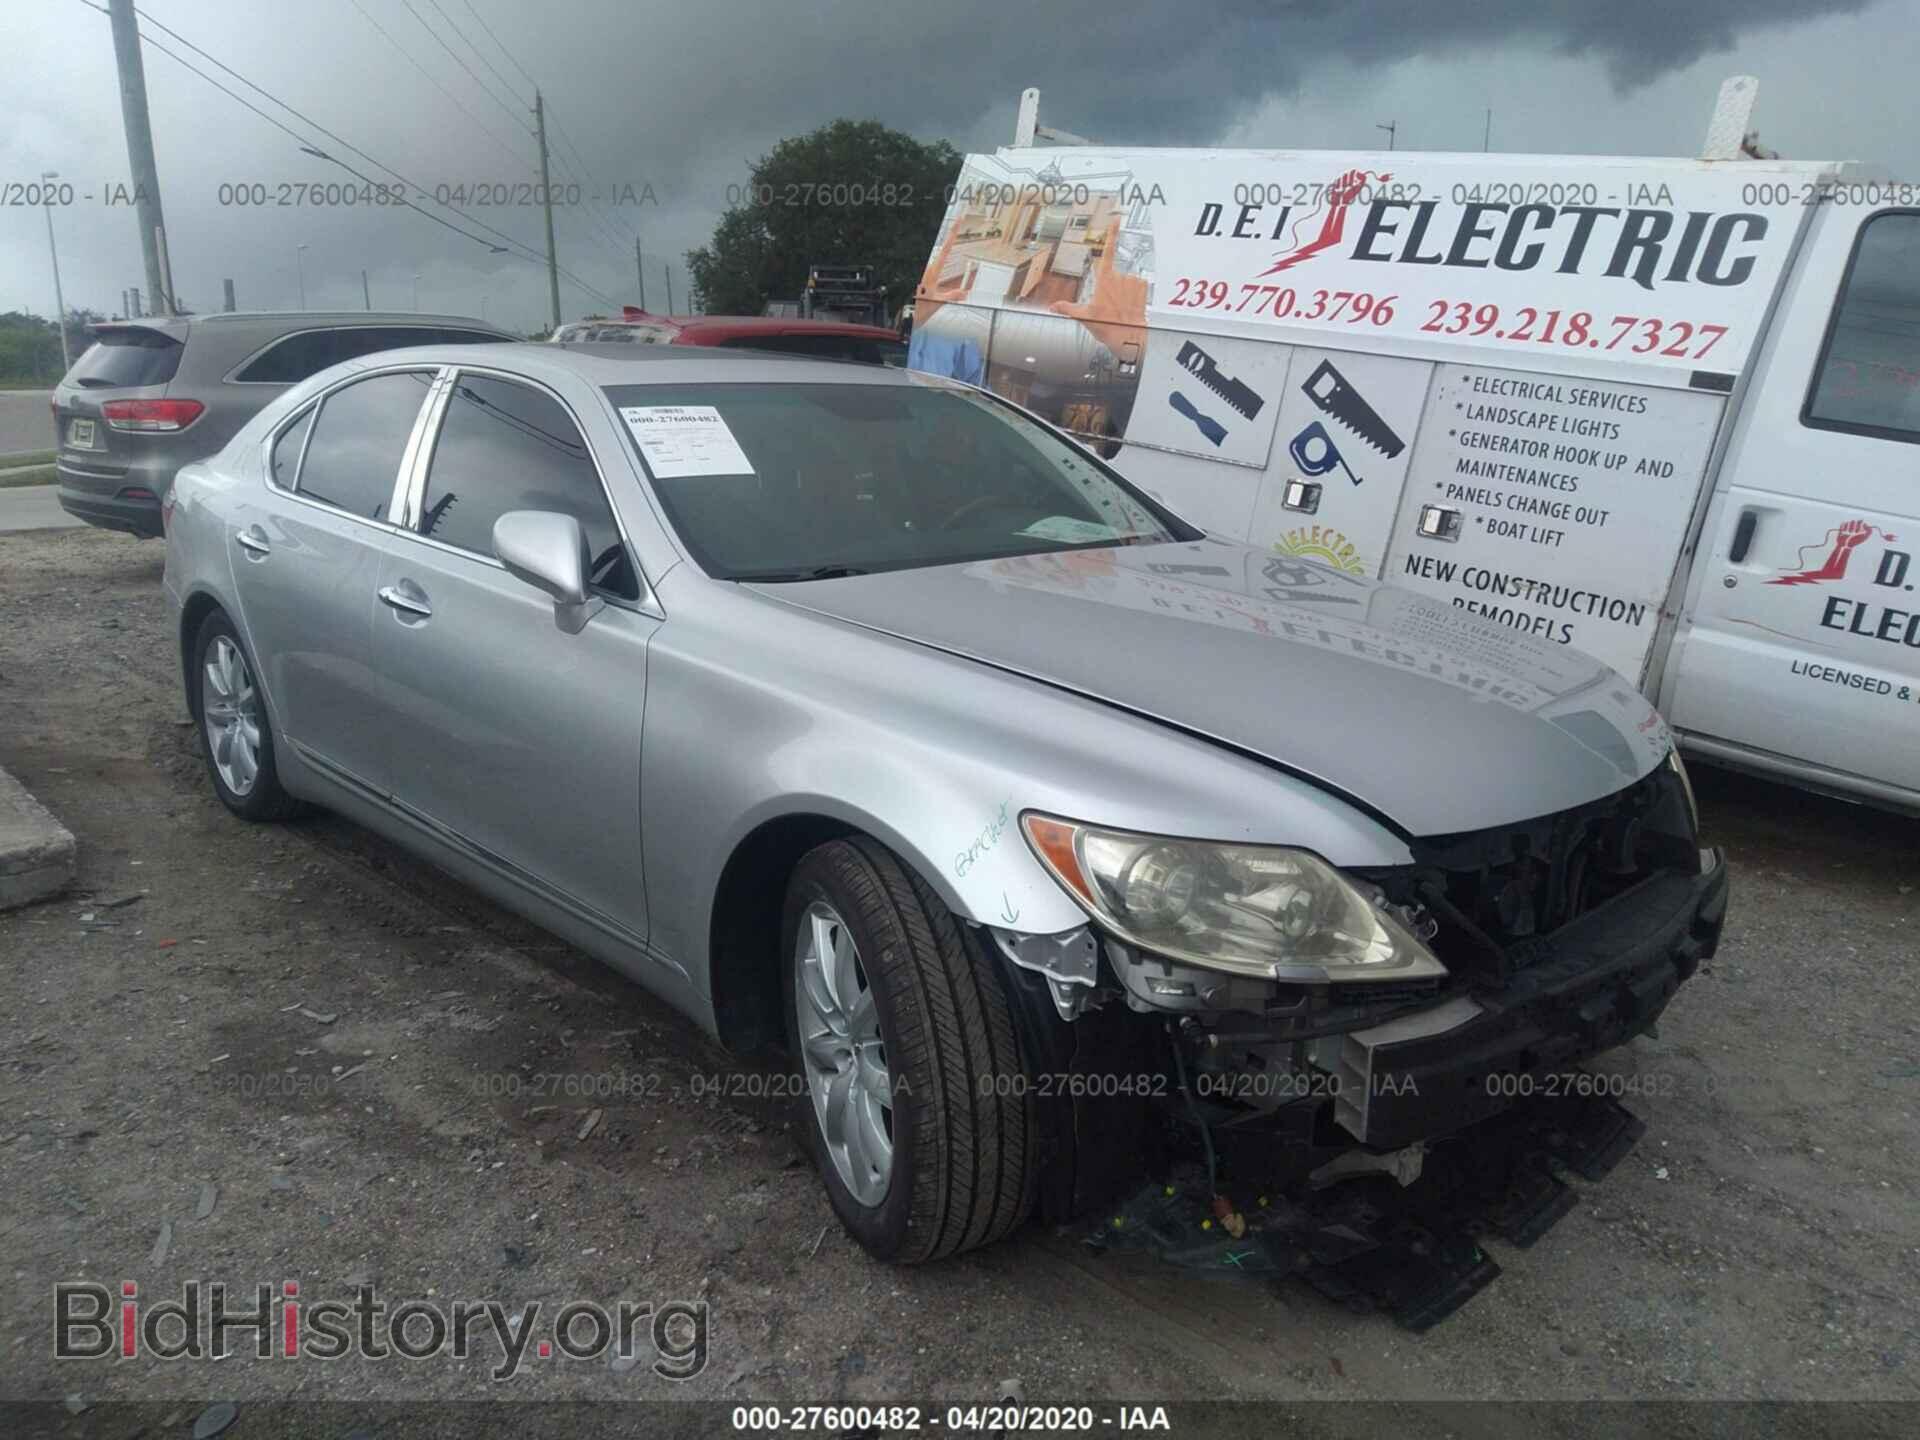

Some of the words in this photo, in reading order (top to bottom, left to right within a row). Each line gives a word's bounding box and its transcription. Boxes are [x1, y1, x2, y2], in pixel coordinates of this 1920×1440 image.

[1348, 200, 1769, 290] ELECTRIC
[1168, 278, 1400, 326] 239.770.3796
[1420, 300, 1728, 360] 239.218.7327
[1473, 376, 1563, 404] ELECTRICAL
[1568, 388, 1648, 414] SERVICES
[1466, 403, 1558, 432] LANDSCAPE
[1561, 417, 1621, 440] LIGHTS
[1455, 457, 1579, 492] MAINTENANCES
[1459, 430, 1550, 459] GENERATOR
[1553, 444, 1601, 467] HOOK
[1603, 452, 1627, 471] UP
[1634, 458, 1674, 478] AND
[1446, 483, 1503, 508] PANELS
[1506, 494, 1571, 521] CHANGE
[1574, 507, 1610, 527] OUT
[1487, 518, 1529, 540] BOAT
[1530, 527, 1565, 547] LIFT
[1405, 553, 1457, 583] NEW
[1462, 566, 1646, 627] CONSTRUCTION
[1791, 659, 1892, 695] LICENSED
[1897, 686, 1911, 701] &
